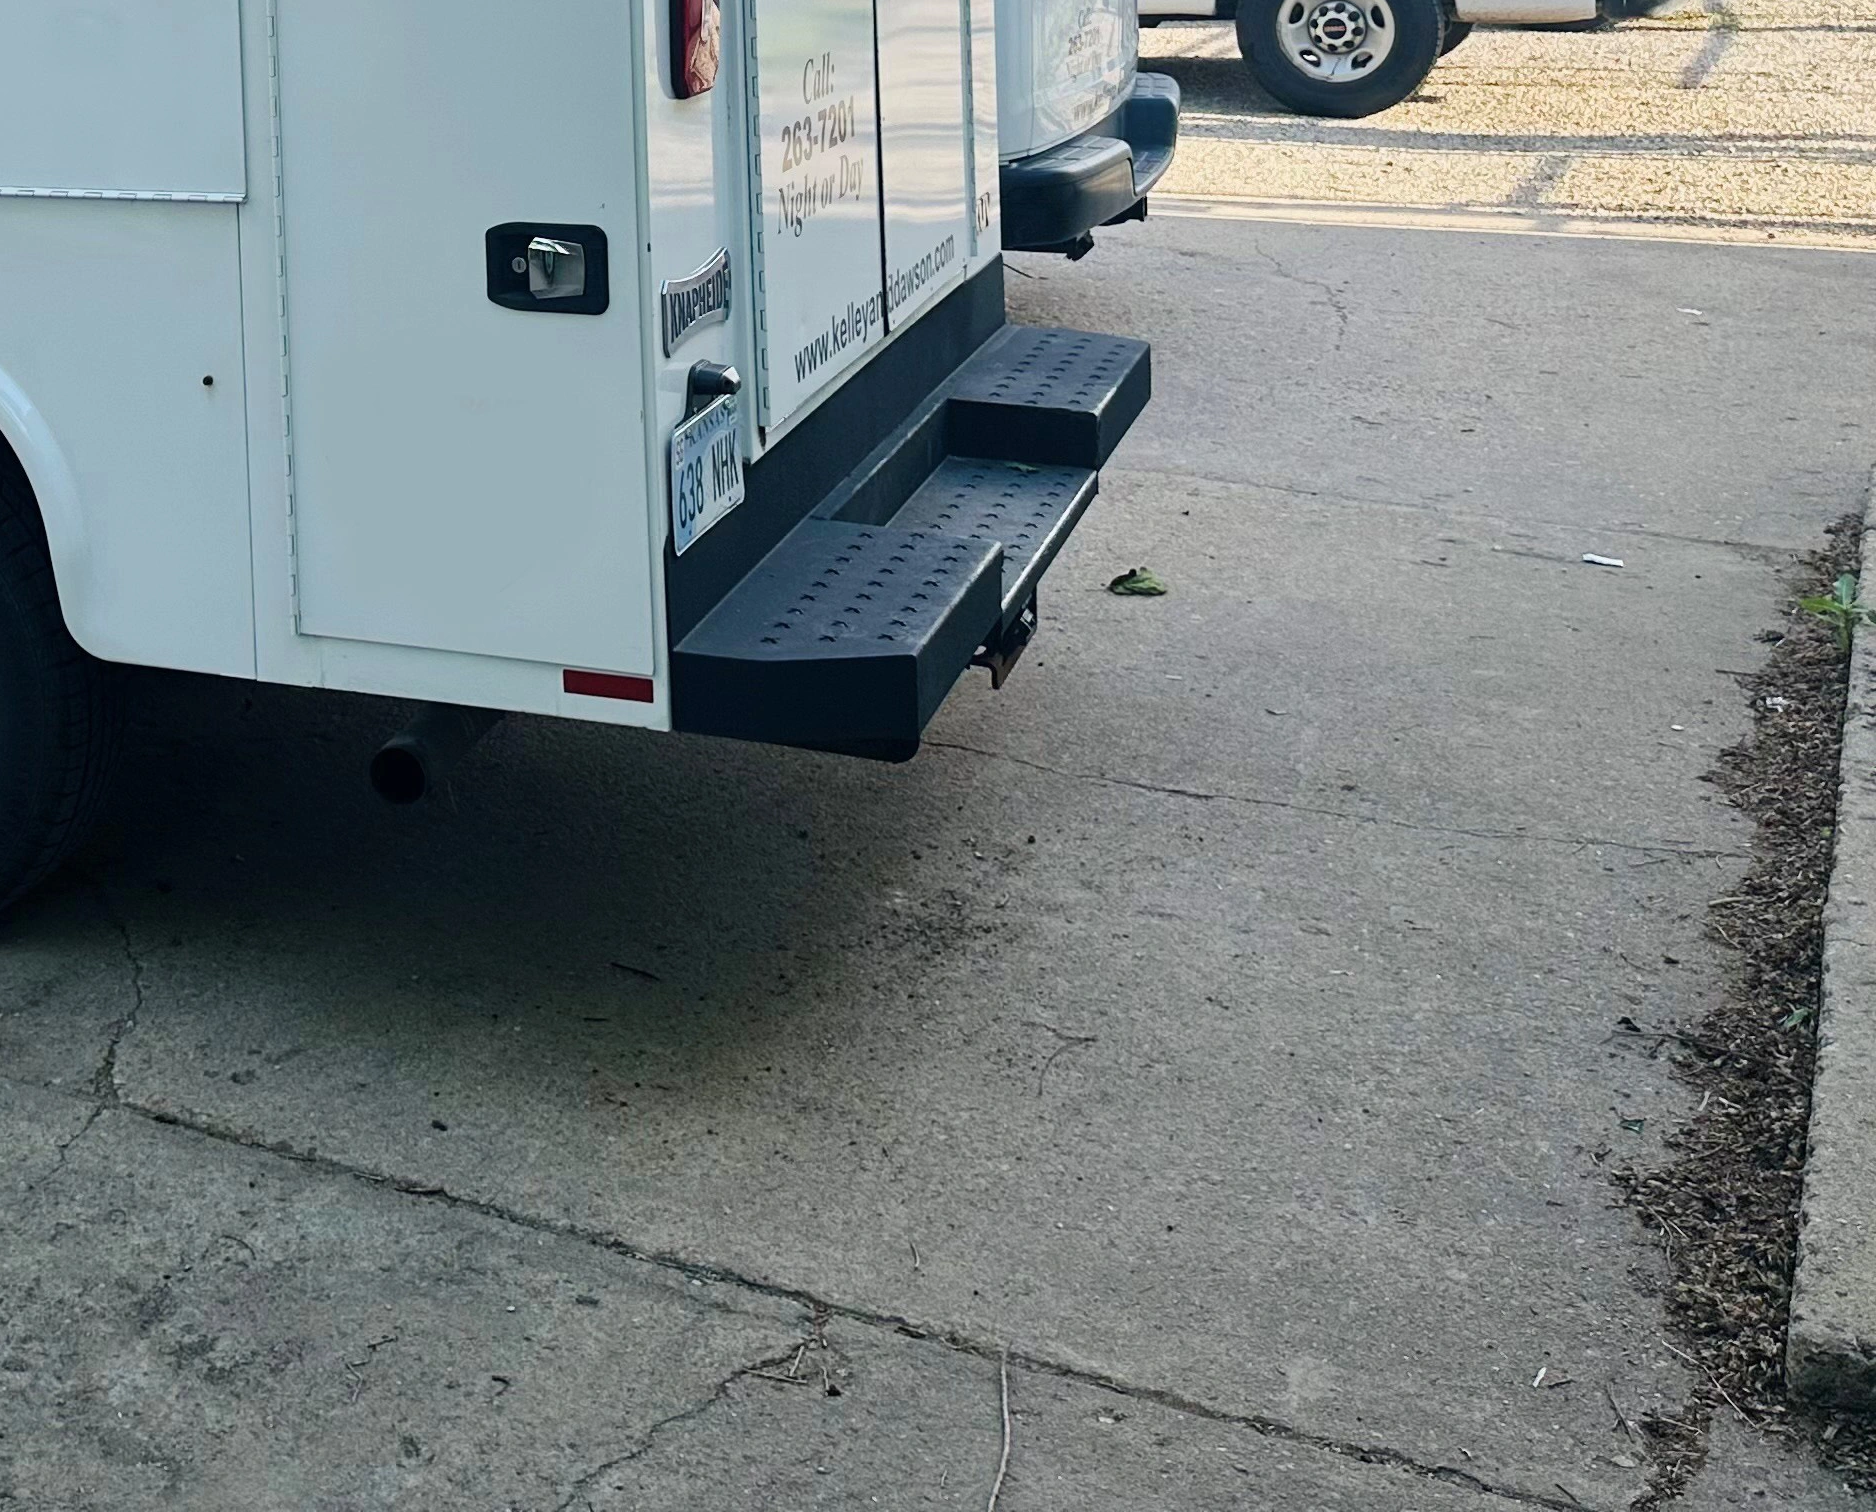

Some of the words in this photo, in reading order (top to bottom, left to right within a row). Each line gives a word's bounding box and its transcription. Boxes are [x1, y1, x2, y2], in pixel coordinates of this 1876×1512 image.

[802, 51, 836, 105] Call:
[781, 95, 856, 173] 263-7201
[778, 173, 818, 237] Night
[820, 173, 836, 209] or
[838, 154, 864, 201] Day
[669, 266, 732, 344] KNAPHEIDE
[794, 233, 956, 384] www.kelleyanddawson.com
[679, 454, 704, 529] 638
[711, 427, 740, 503] NHK
